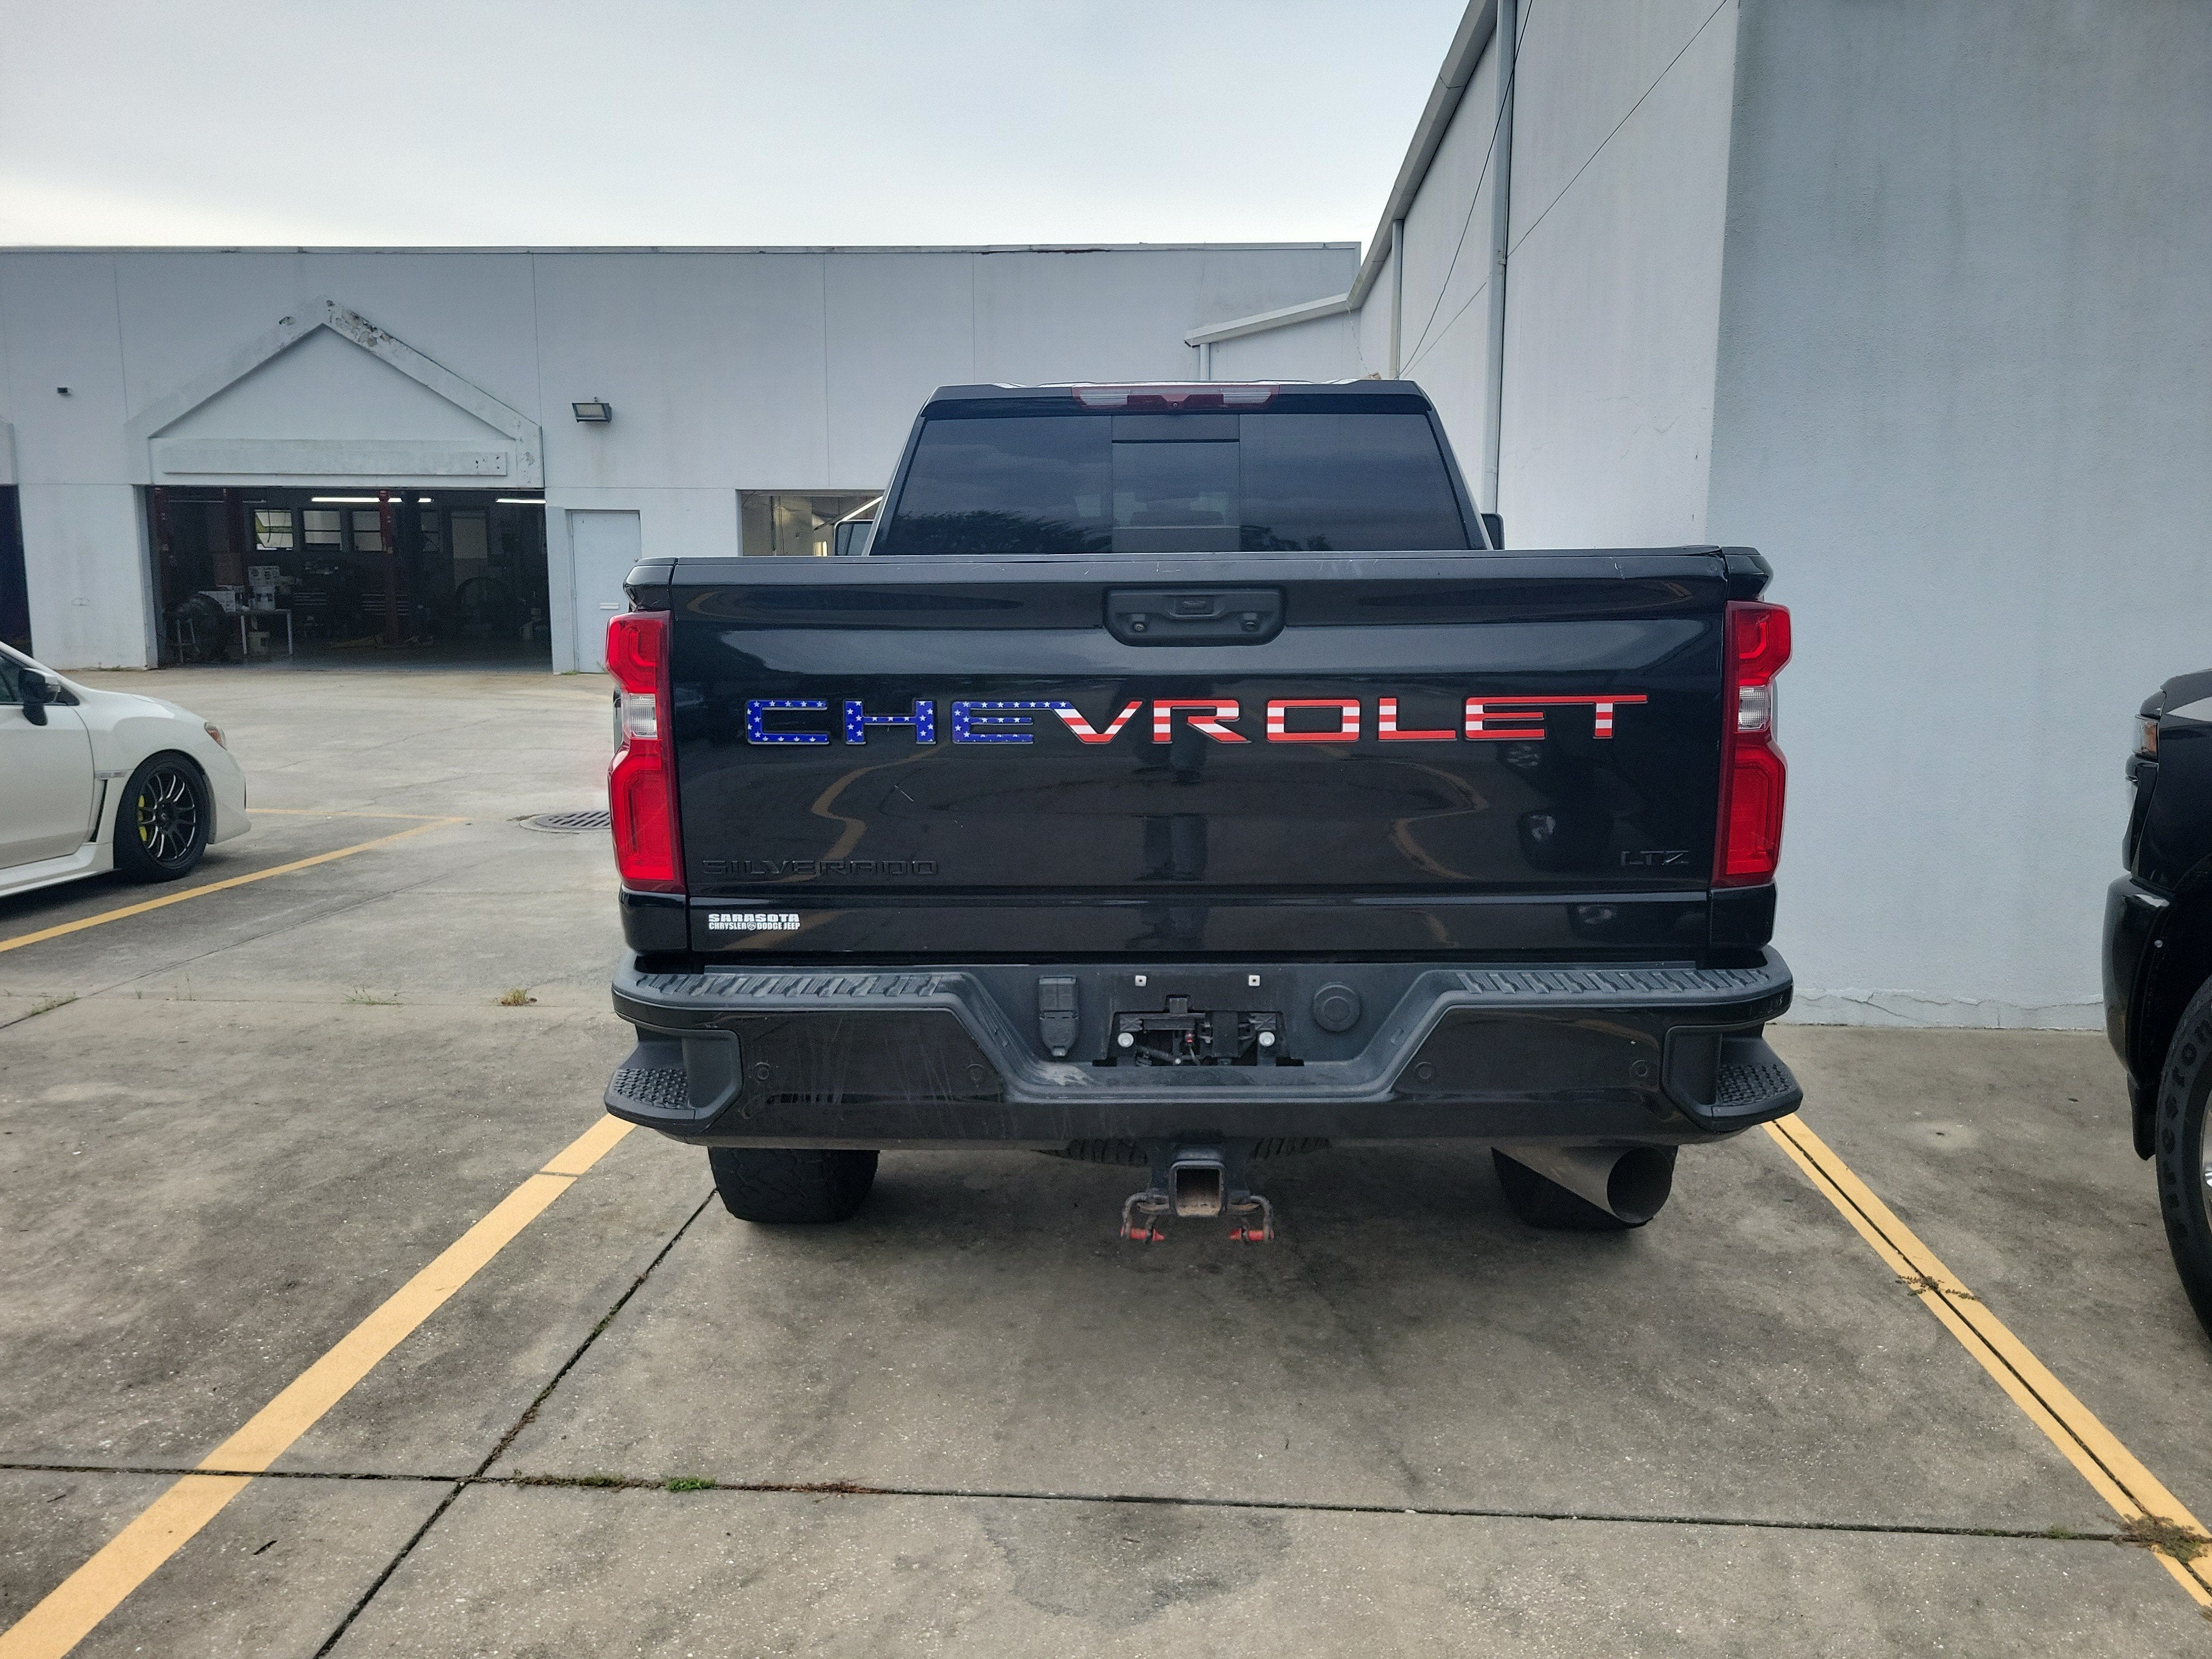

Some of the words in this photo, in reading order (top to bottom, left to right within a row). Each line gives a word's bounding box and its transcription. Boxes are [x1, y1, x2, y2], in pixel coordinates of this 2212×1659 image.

[746, 694, 1649, 745] CHEVROLET
[1620, 850, 1689, 866] LTZ
[702, 859, 939, 875] SILVERADO
[708, 913, 800, 922] SARASOTA
[708, 922, 747, 930] CHRYSLER
[757, 922, 782, 930] DODGE
[783, 922, 801, 930] JEEP
